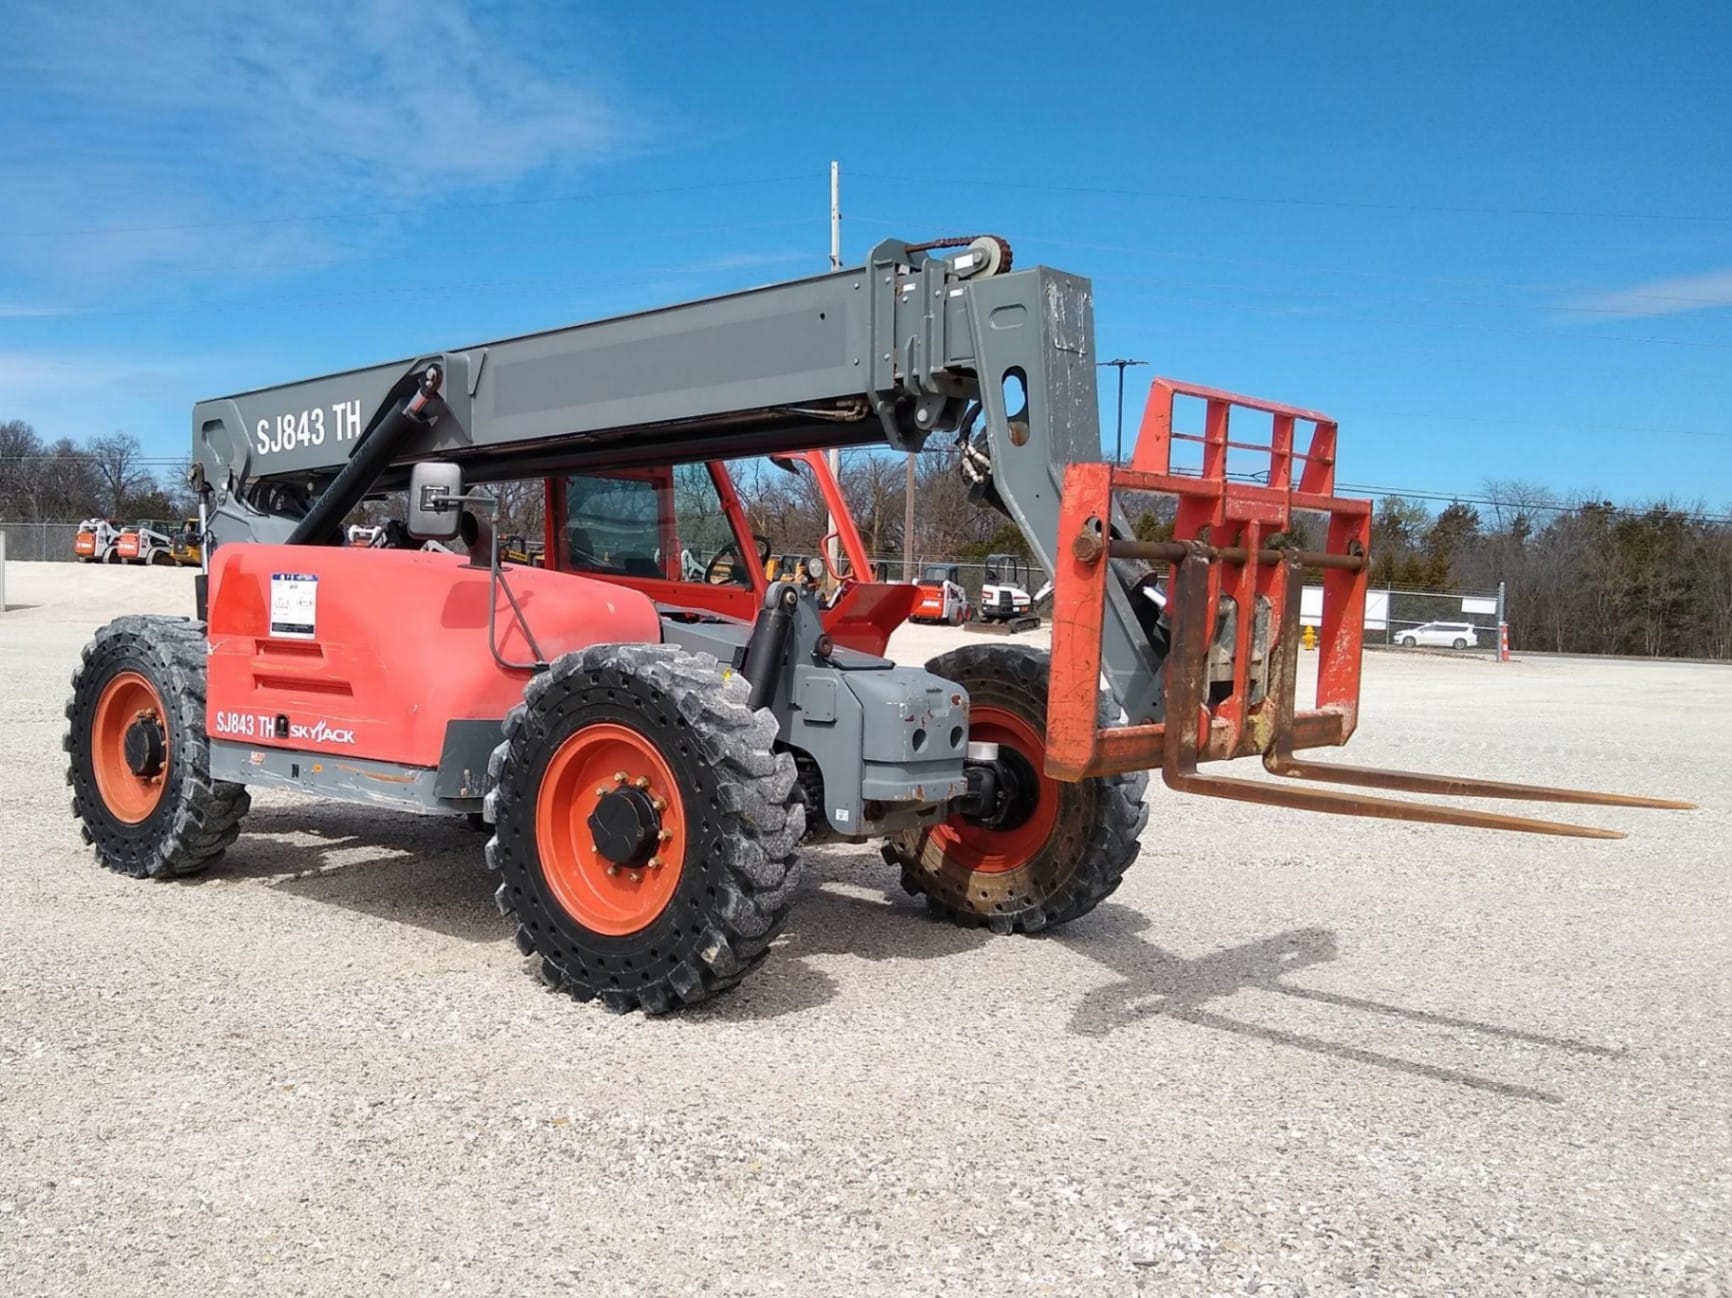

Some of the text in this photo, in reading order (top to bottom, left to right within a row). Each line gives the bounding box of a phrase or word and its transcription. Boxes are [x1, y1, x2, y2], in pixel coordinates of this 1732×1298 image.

[257, 400, 361, 455] SJ843 TH
[216, 711, 275, 738] SJ843 TH
[290, 720, 355, 743] SKYJACK
